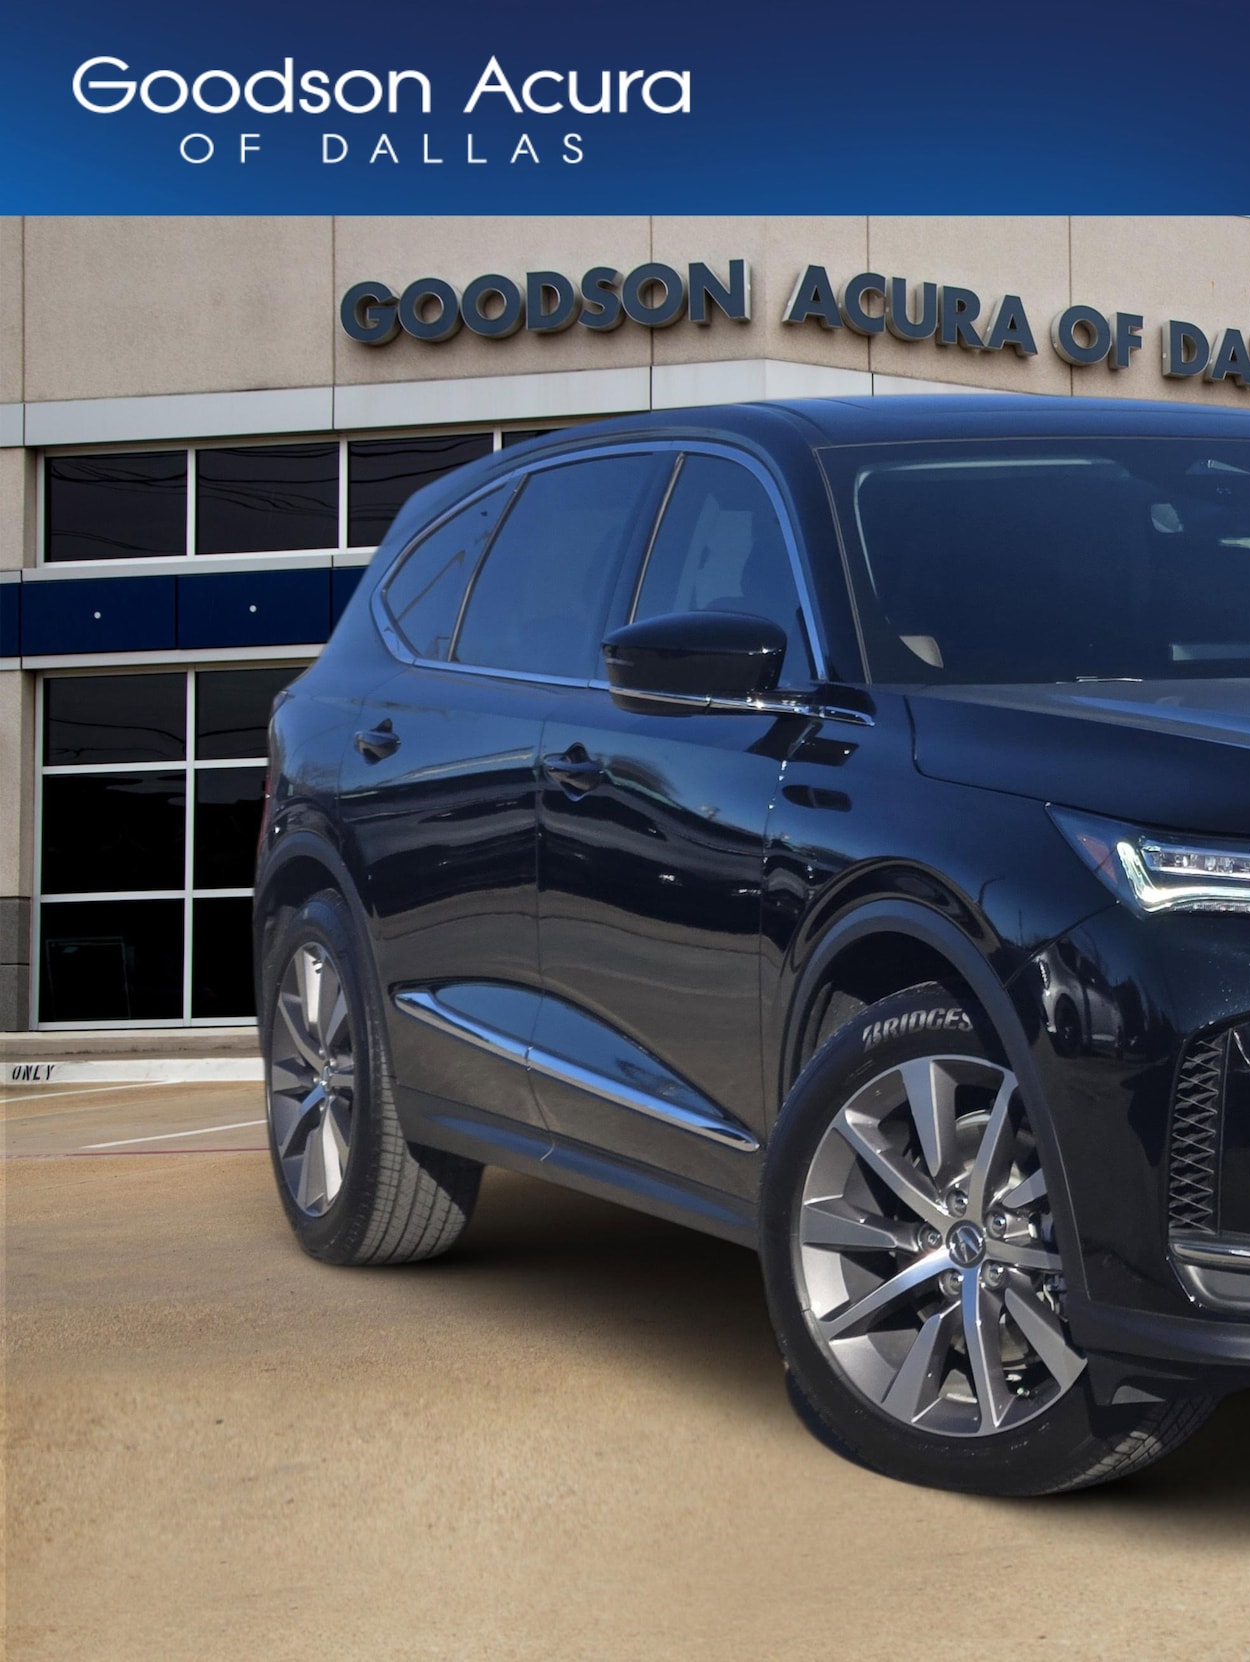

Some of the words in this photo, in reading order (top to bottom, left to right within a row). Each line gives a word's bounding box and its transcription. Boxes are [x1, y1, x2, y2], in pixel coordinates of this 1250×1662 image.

[340, 258, 752, 348] GOODSON
[782, 263, 1039, 358] ACURA
[1050, 303, 1145, 368] OF
[12, 1065, 55, 1081] ONLY
